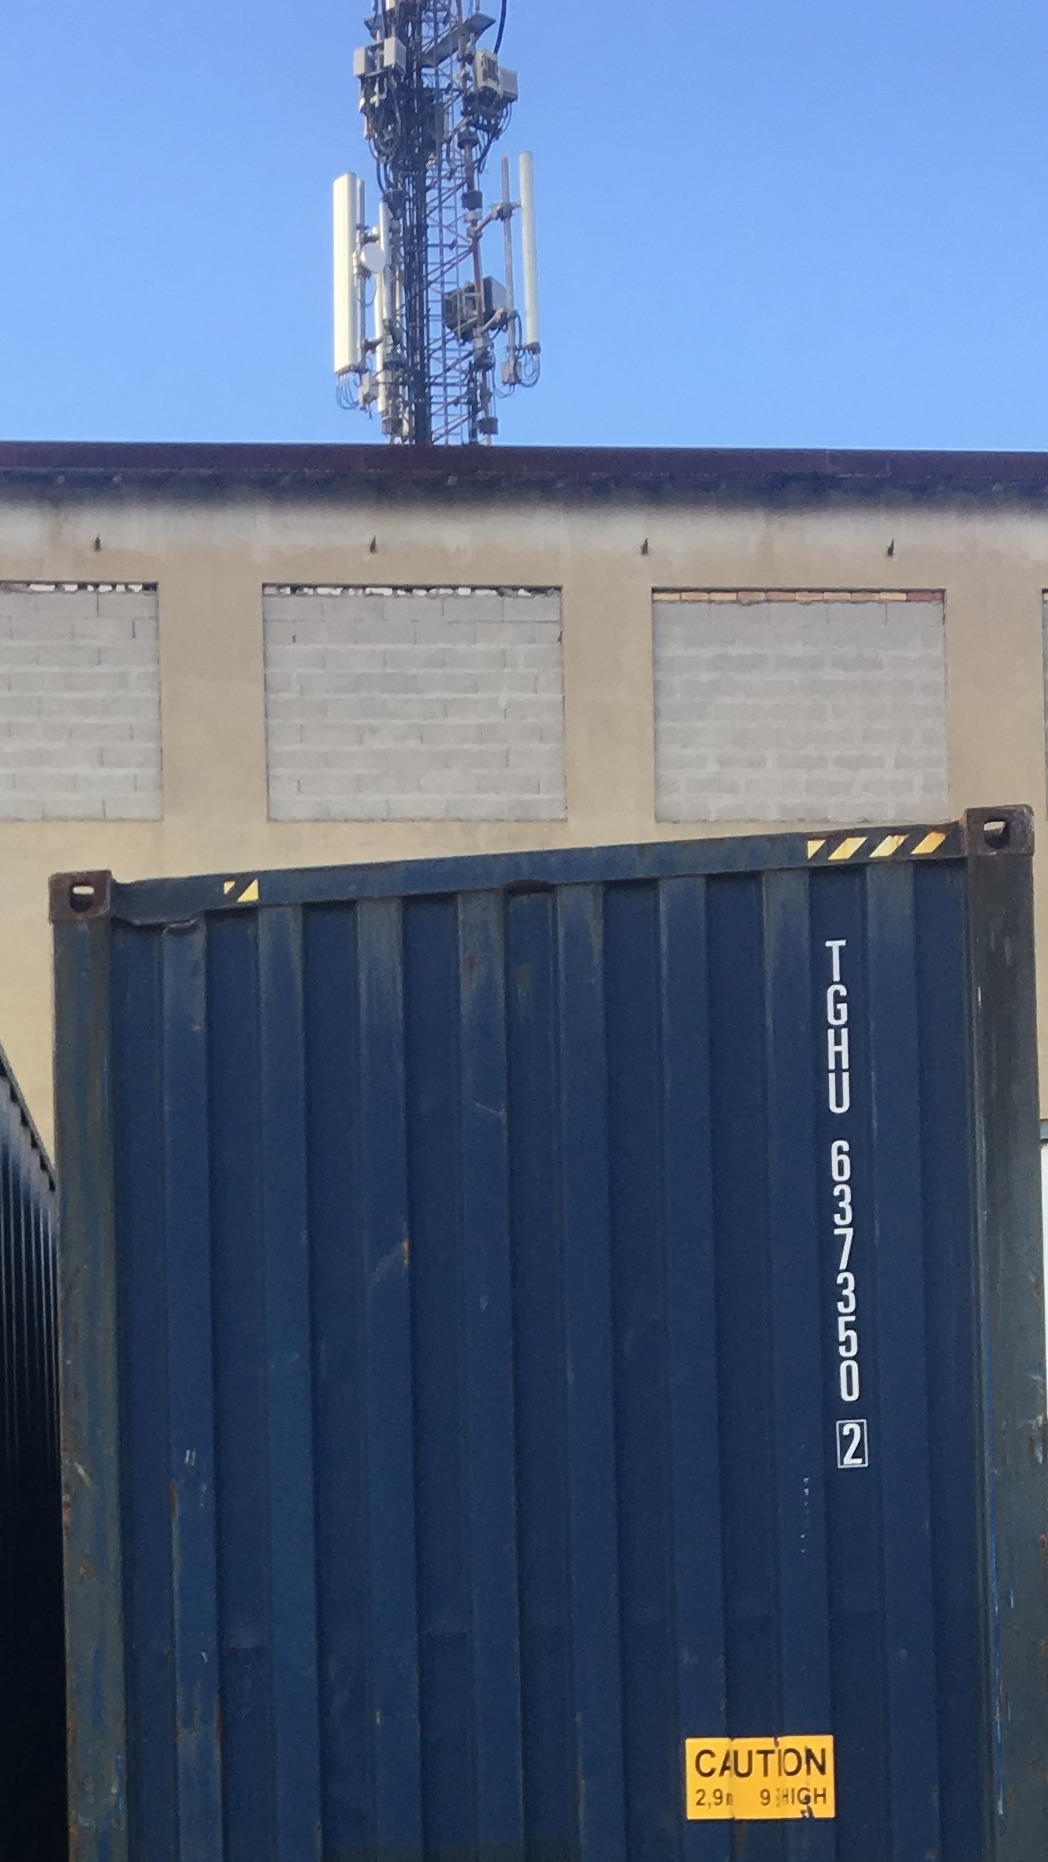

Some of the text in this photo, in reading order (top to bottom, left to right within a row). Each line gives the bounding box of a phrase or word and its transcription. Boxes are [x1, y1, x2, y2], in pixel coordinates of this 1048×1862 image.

[825, 940, 865, 1466] TGHU 637350 2
[695, 1747, 826, 1778] CAUTION
